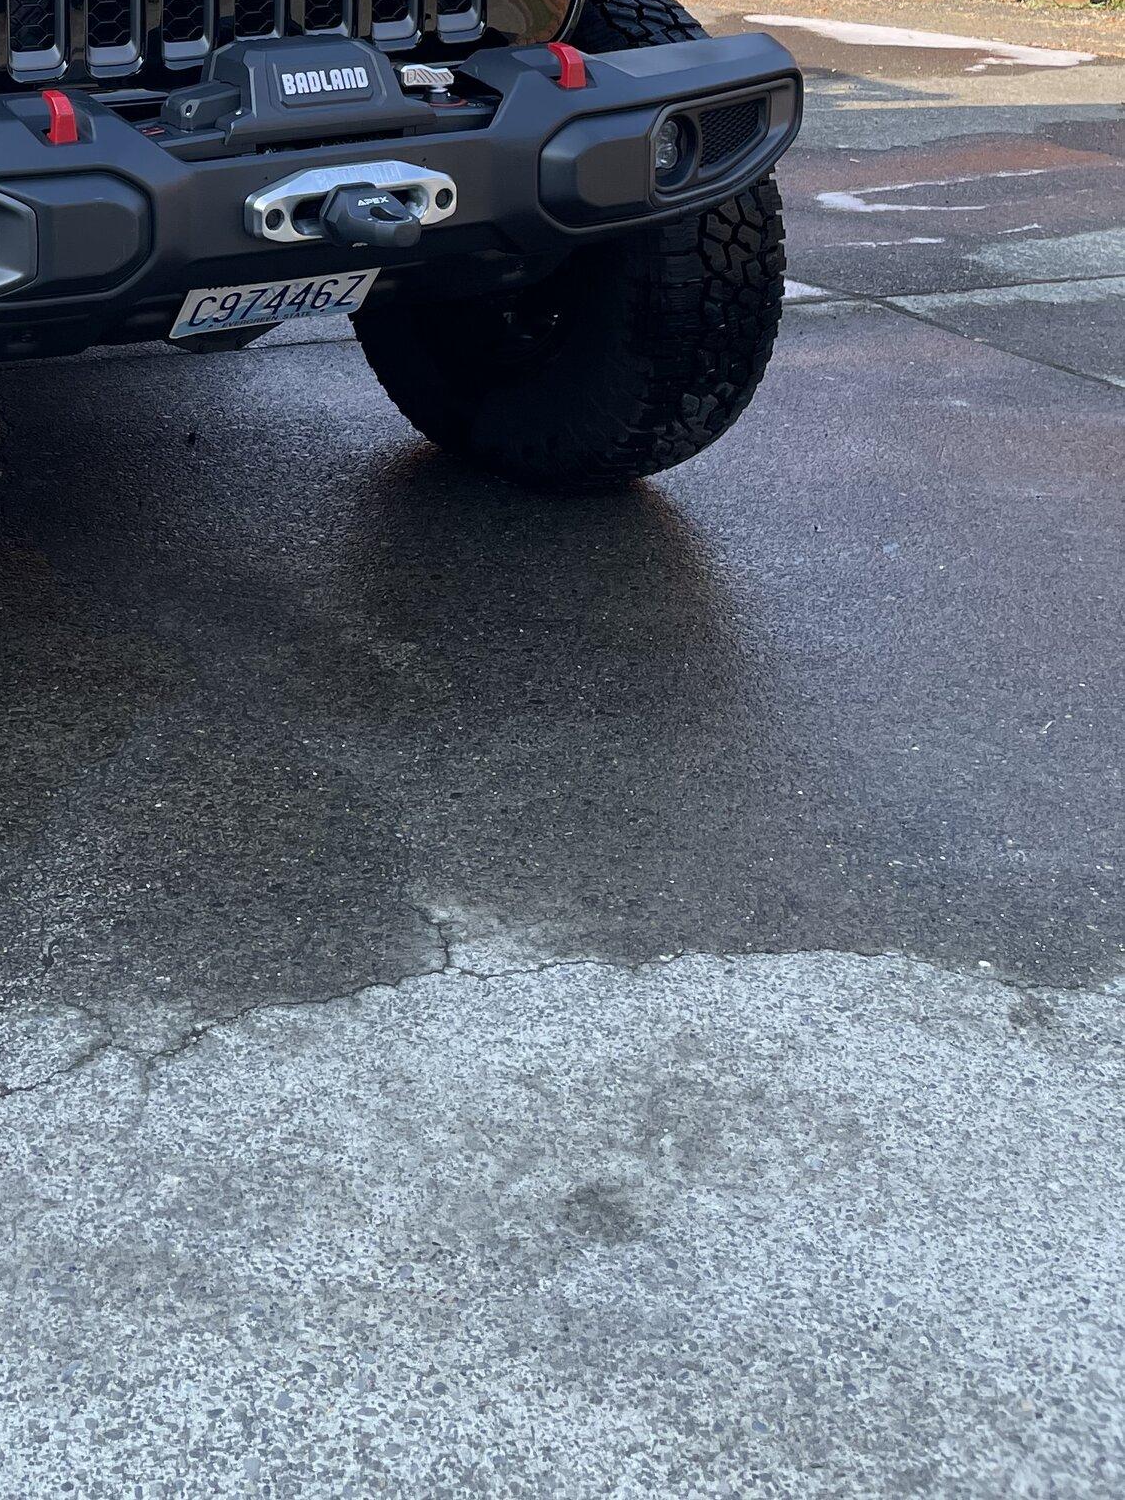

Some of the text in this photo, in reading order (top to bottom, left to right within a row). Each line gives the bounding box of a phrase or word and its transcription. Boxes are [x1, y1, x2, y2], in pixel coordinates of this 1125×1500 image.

[281, 66, 369, 95] BADLAND
[357, 195, 390, 207] APEX
[188, 274, 367, 327] C97446Z
[282, 310, 313, 320] STATE
